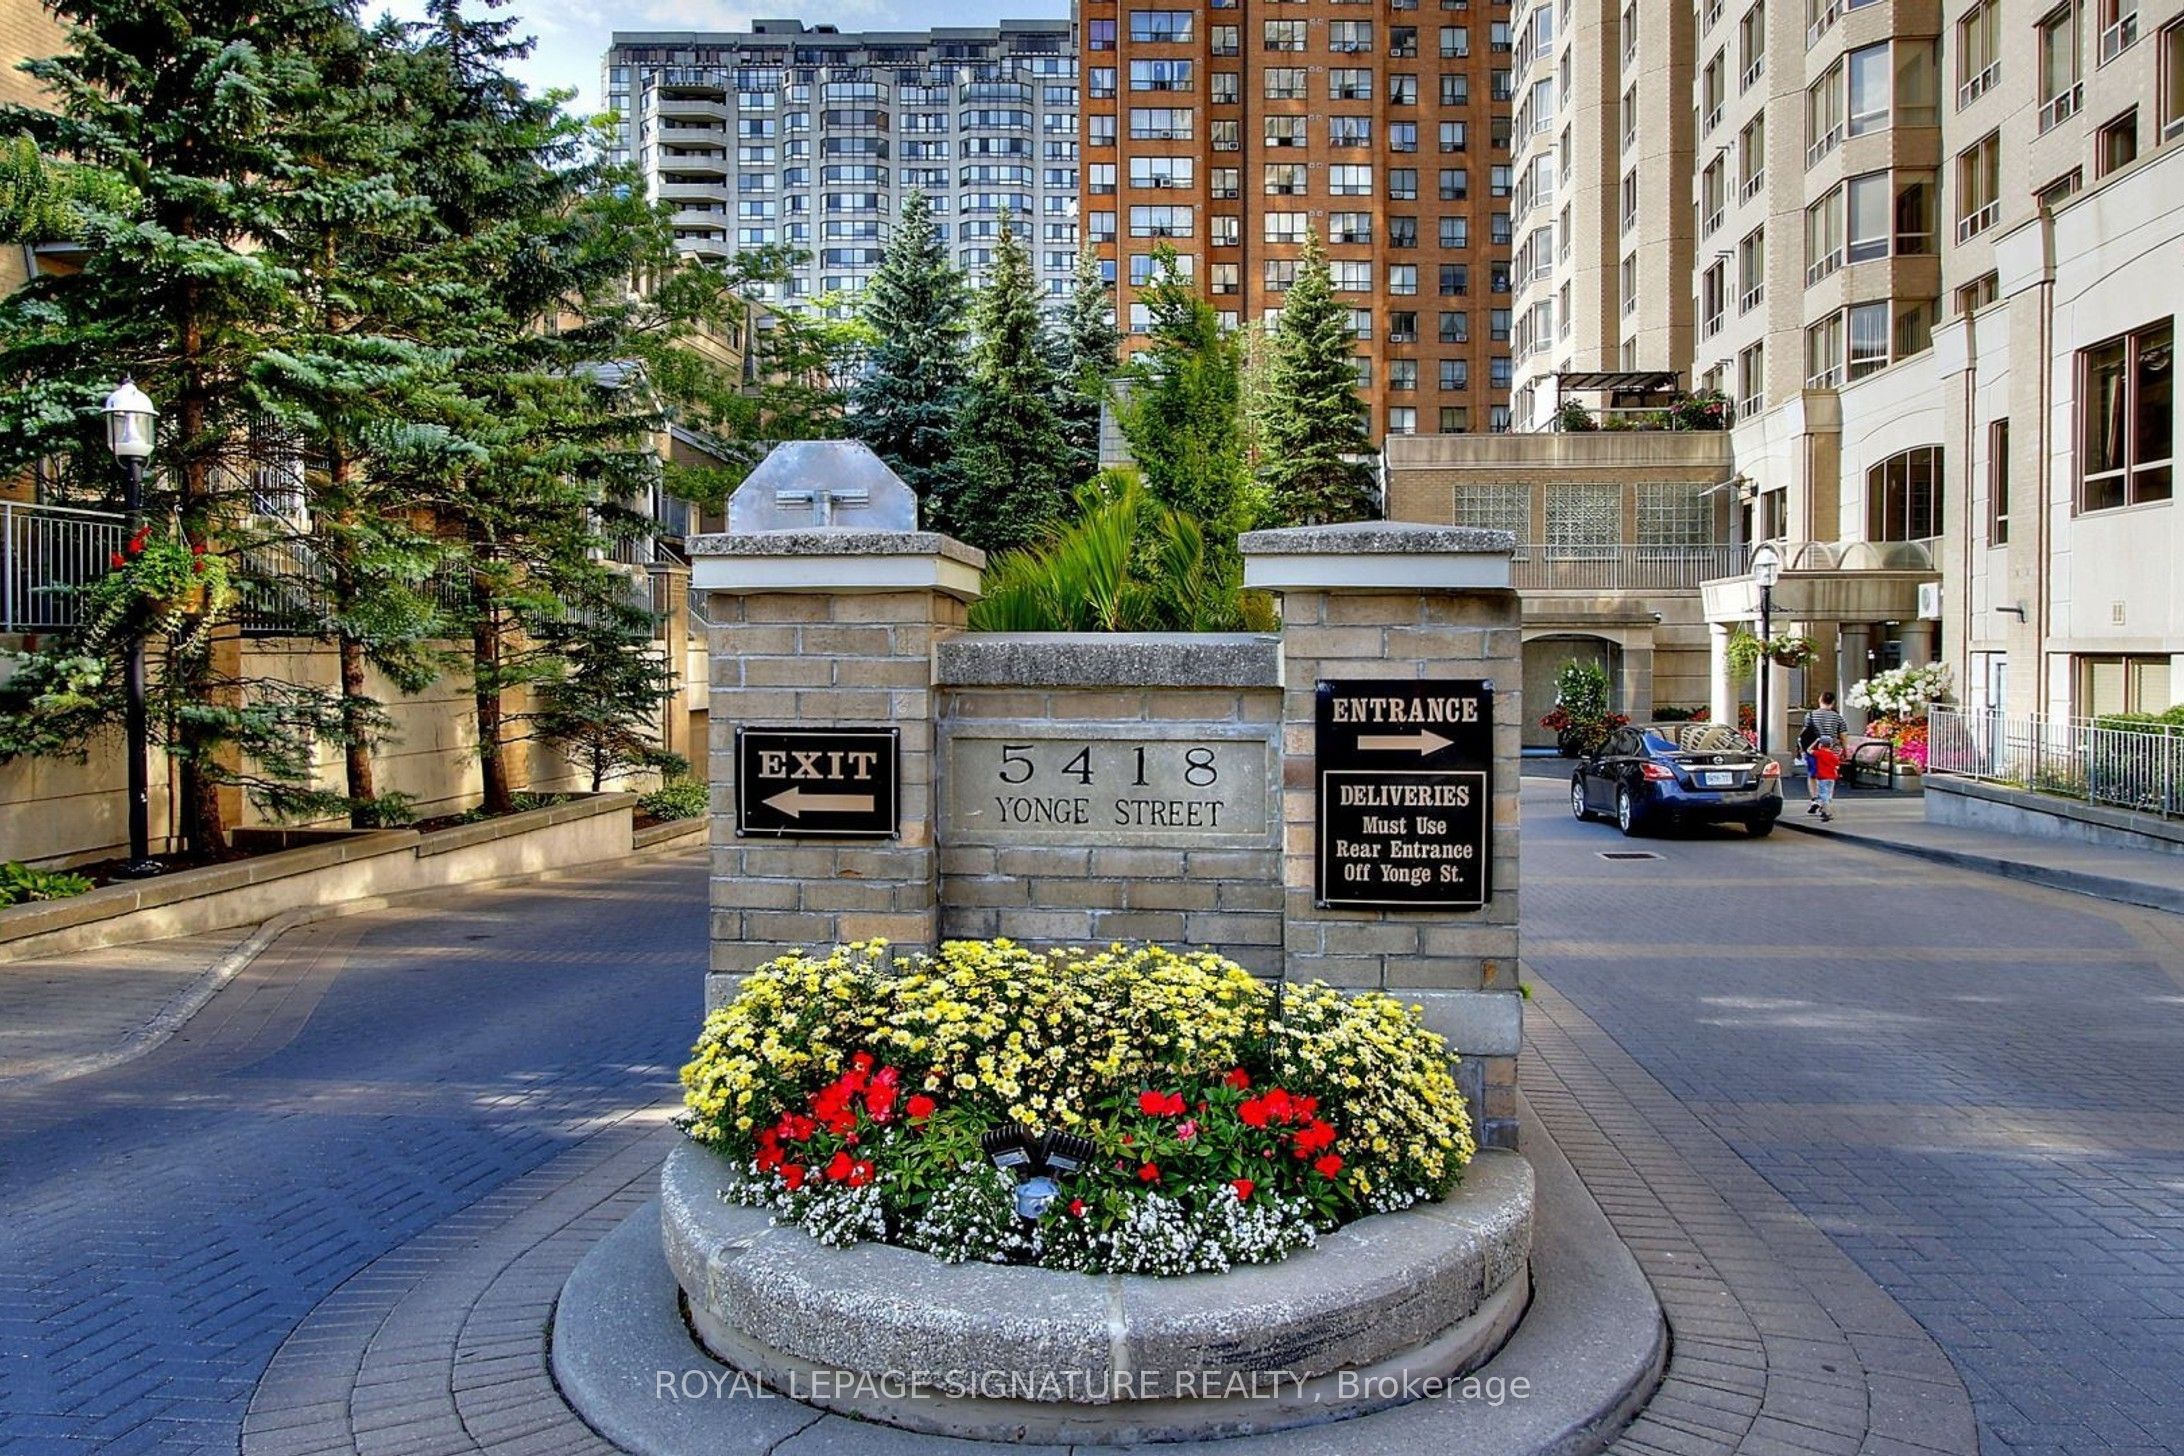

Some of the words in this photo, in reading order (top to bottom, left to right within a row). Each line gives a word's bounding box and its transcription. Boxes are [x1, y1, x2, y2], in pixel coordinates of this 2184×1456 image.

[1332, 697, 1479, 723] ENTRANCE
[758, 750, 878, 780] EXIT
[1339, 784, 1471, 807] DELIVERIES
[995, 796, 1090, 825] YONGE
[1114, 798, 1225, 828] STREET
[1362, 815, 1408, 835] Must
[1415, 816, 1448, 835] Use
[1335, 839, 1382, 858] Rear
[1389, 839, 1473, 859] Entrance
[1343, 863, 1372, 882] Off
[1380, 863, 1432, 887] Yonge
[1439, 863, 1465, 883] St.
